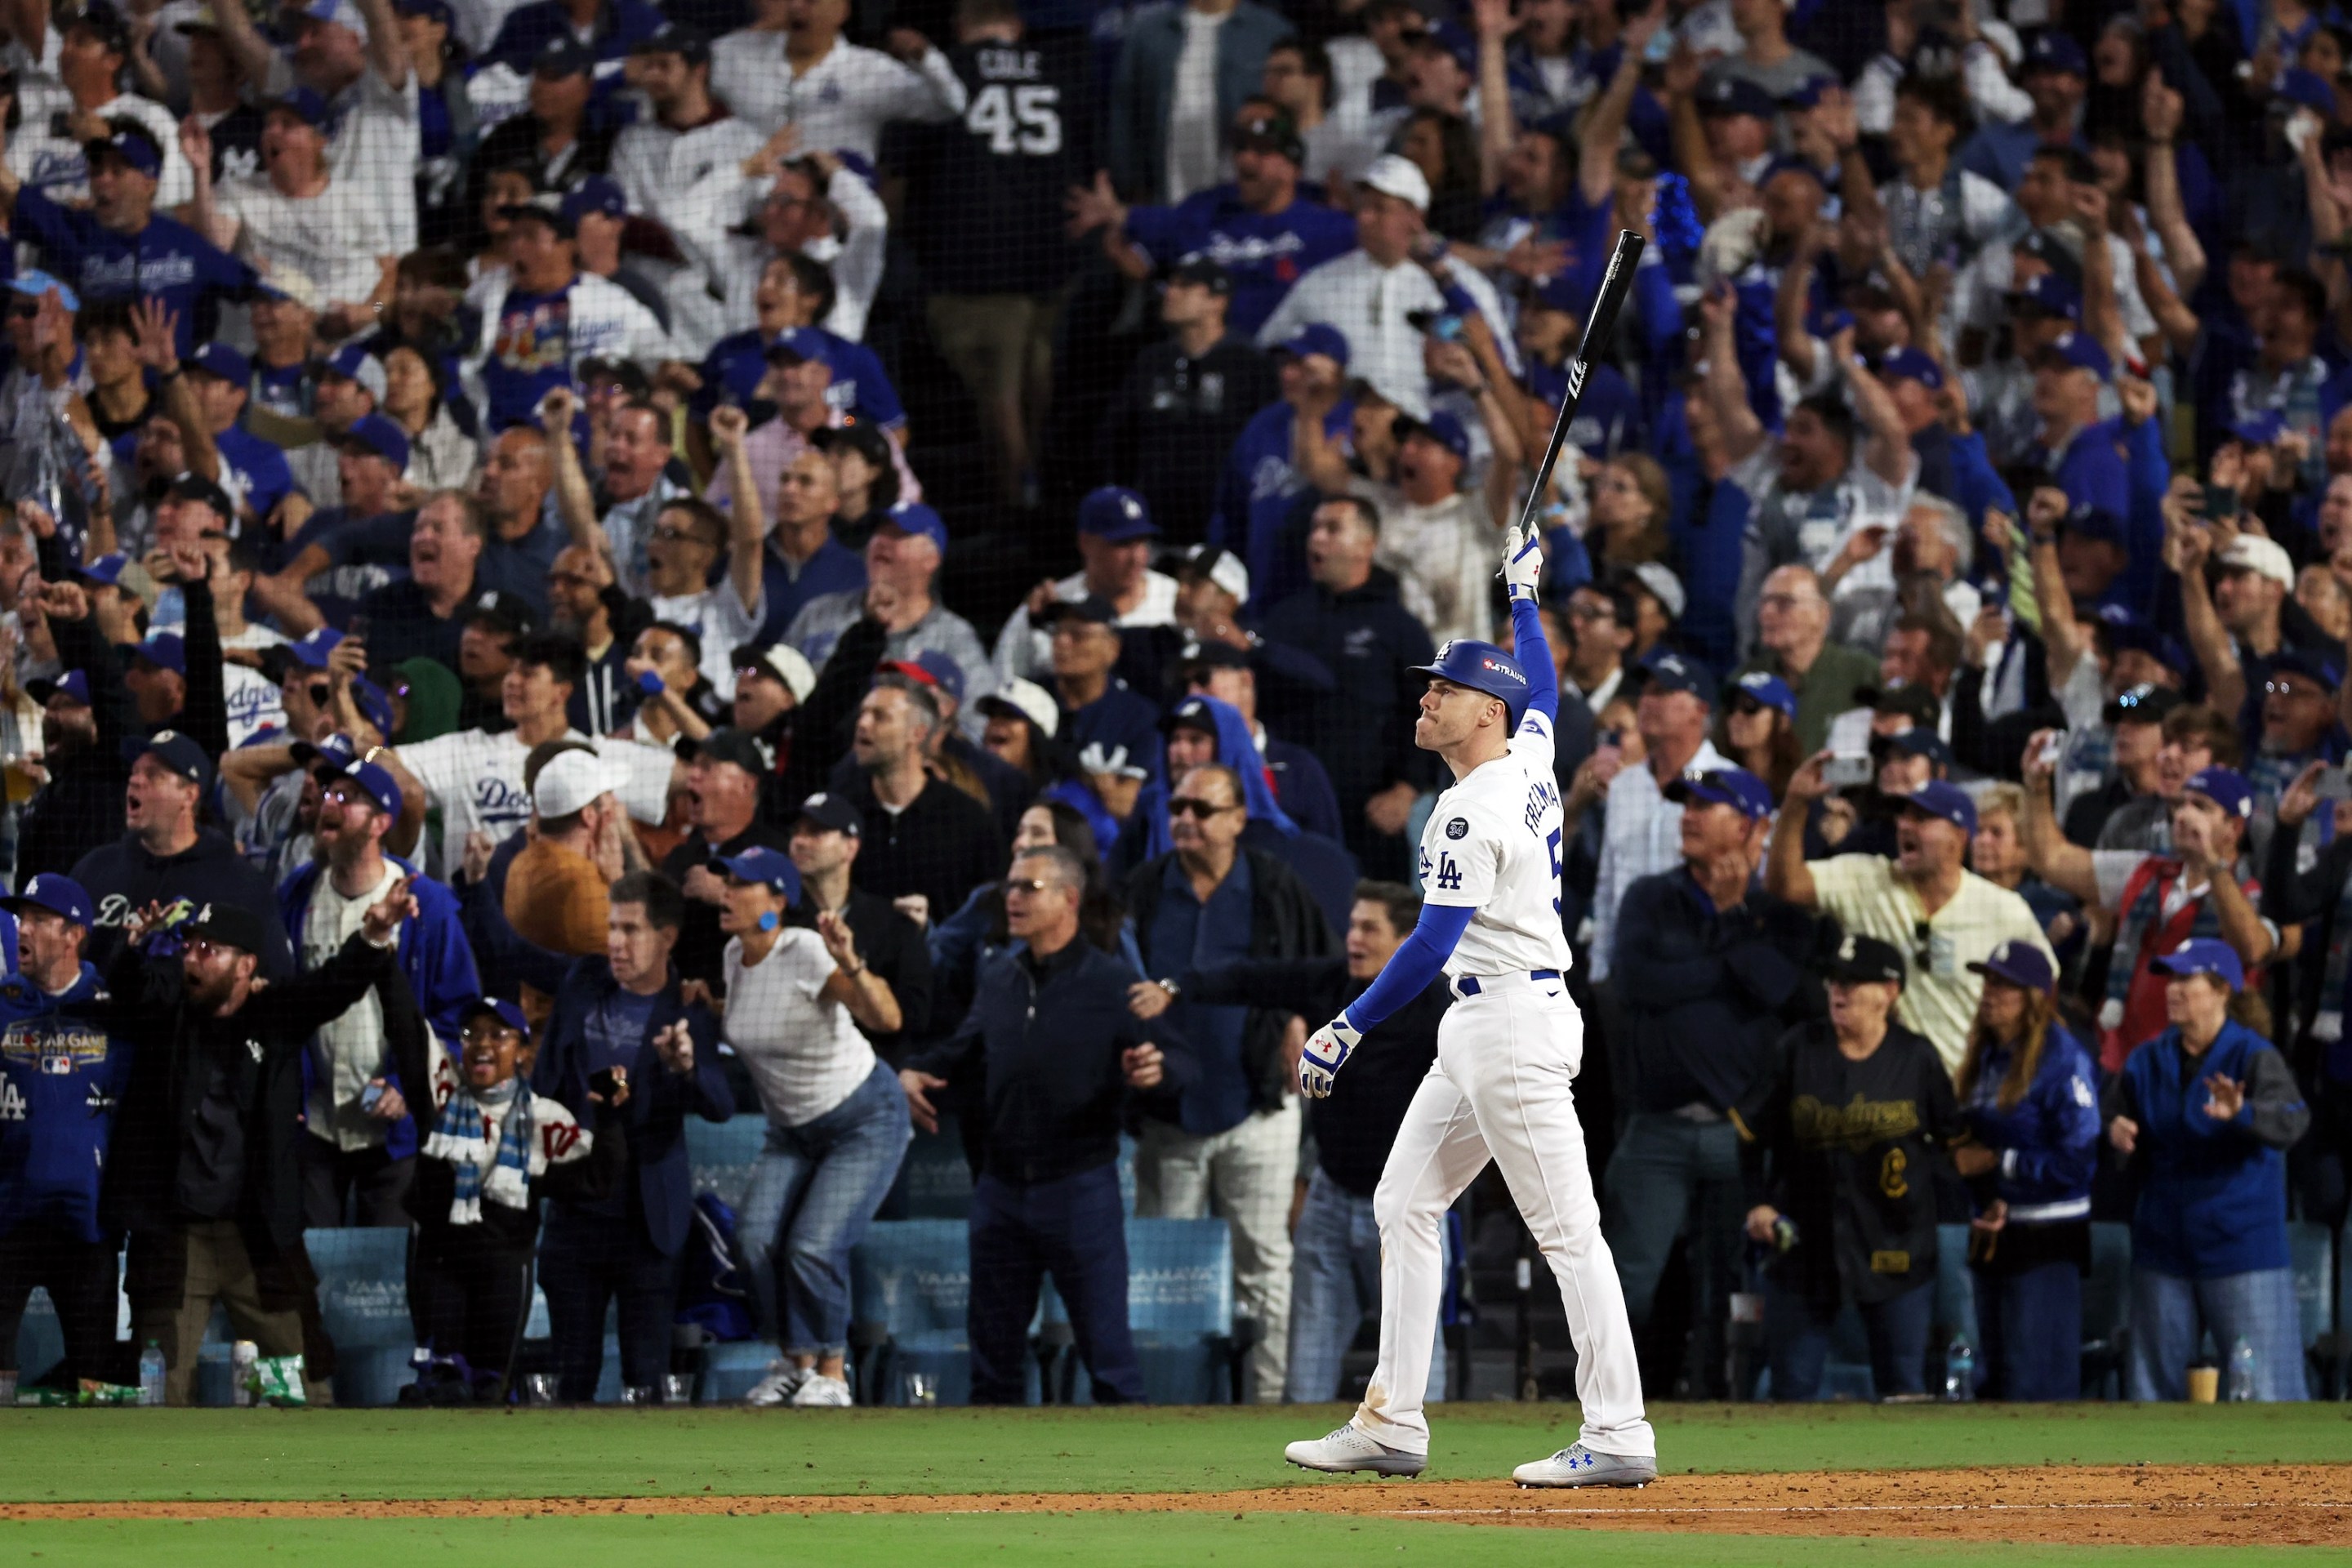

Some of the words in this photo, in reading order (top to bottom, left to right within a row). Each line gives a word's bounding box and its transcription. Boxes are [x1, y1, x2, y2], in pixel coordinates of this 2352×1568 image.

[967, 84, 1061, 154] 45
[1575, 361, 1588, 394] marucci
[1494, 663, 1527, 686] STRAUSS
[1525, 782, 1563, 838] FREEMA
[1448, 825, 1464, 837] 34
[1437, 851, 1463, 890] LA
[1, 1033, 24, 1047] ALL
[31, 1031, 66, 1047] SAR
